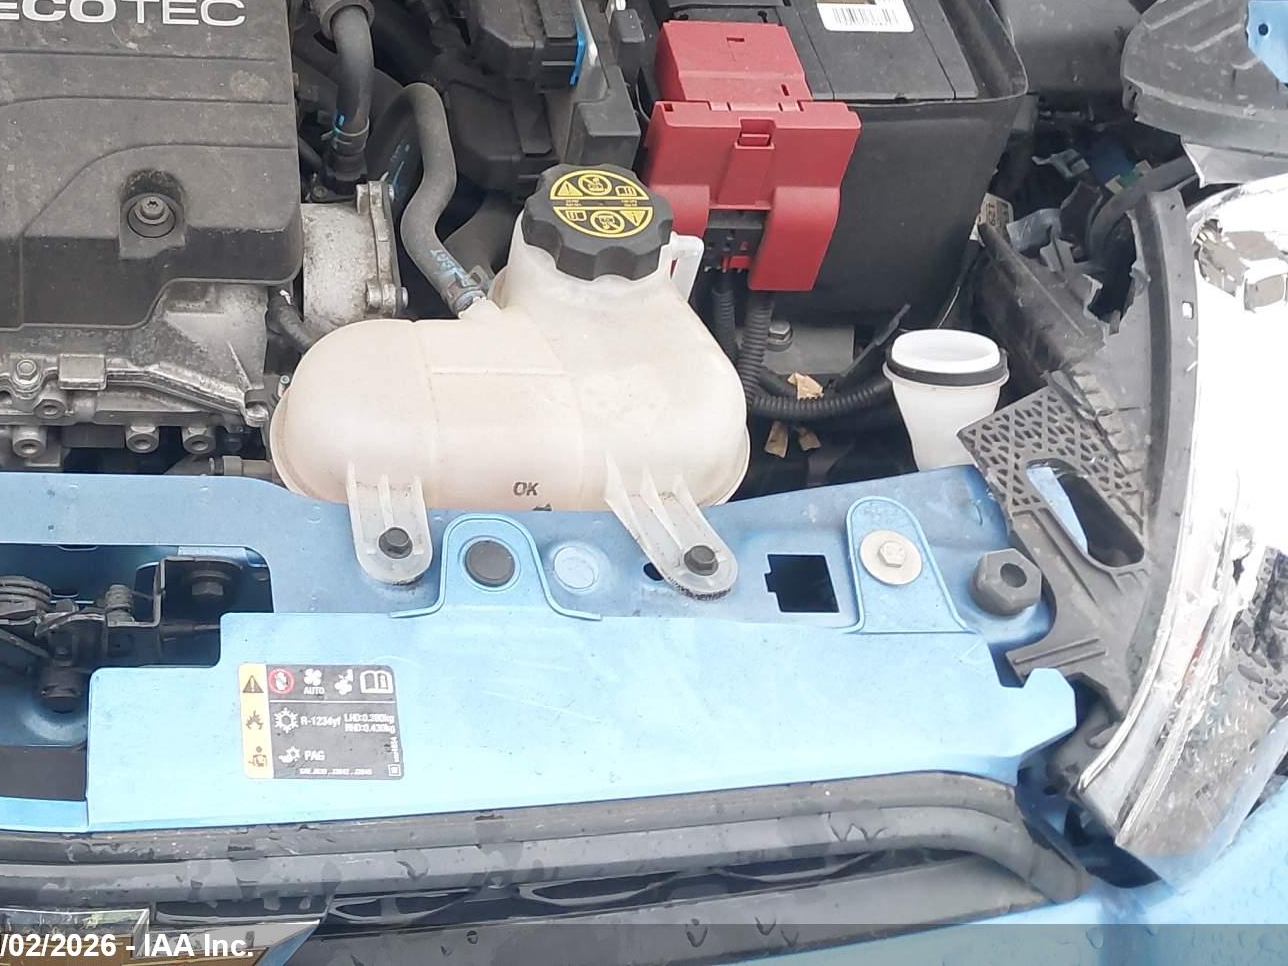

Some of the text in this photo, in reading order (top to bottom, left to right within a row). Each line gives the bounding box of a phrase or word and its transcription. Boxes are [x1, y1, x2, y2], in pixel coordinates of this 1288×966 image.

[513, 481, 539, 496] OK
[304, 687, 325, 695] AUTO
[304, 750, 325, 761] PAG
